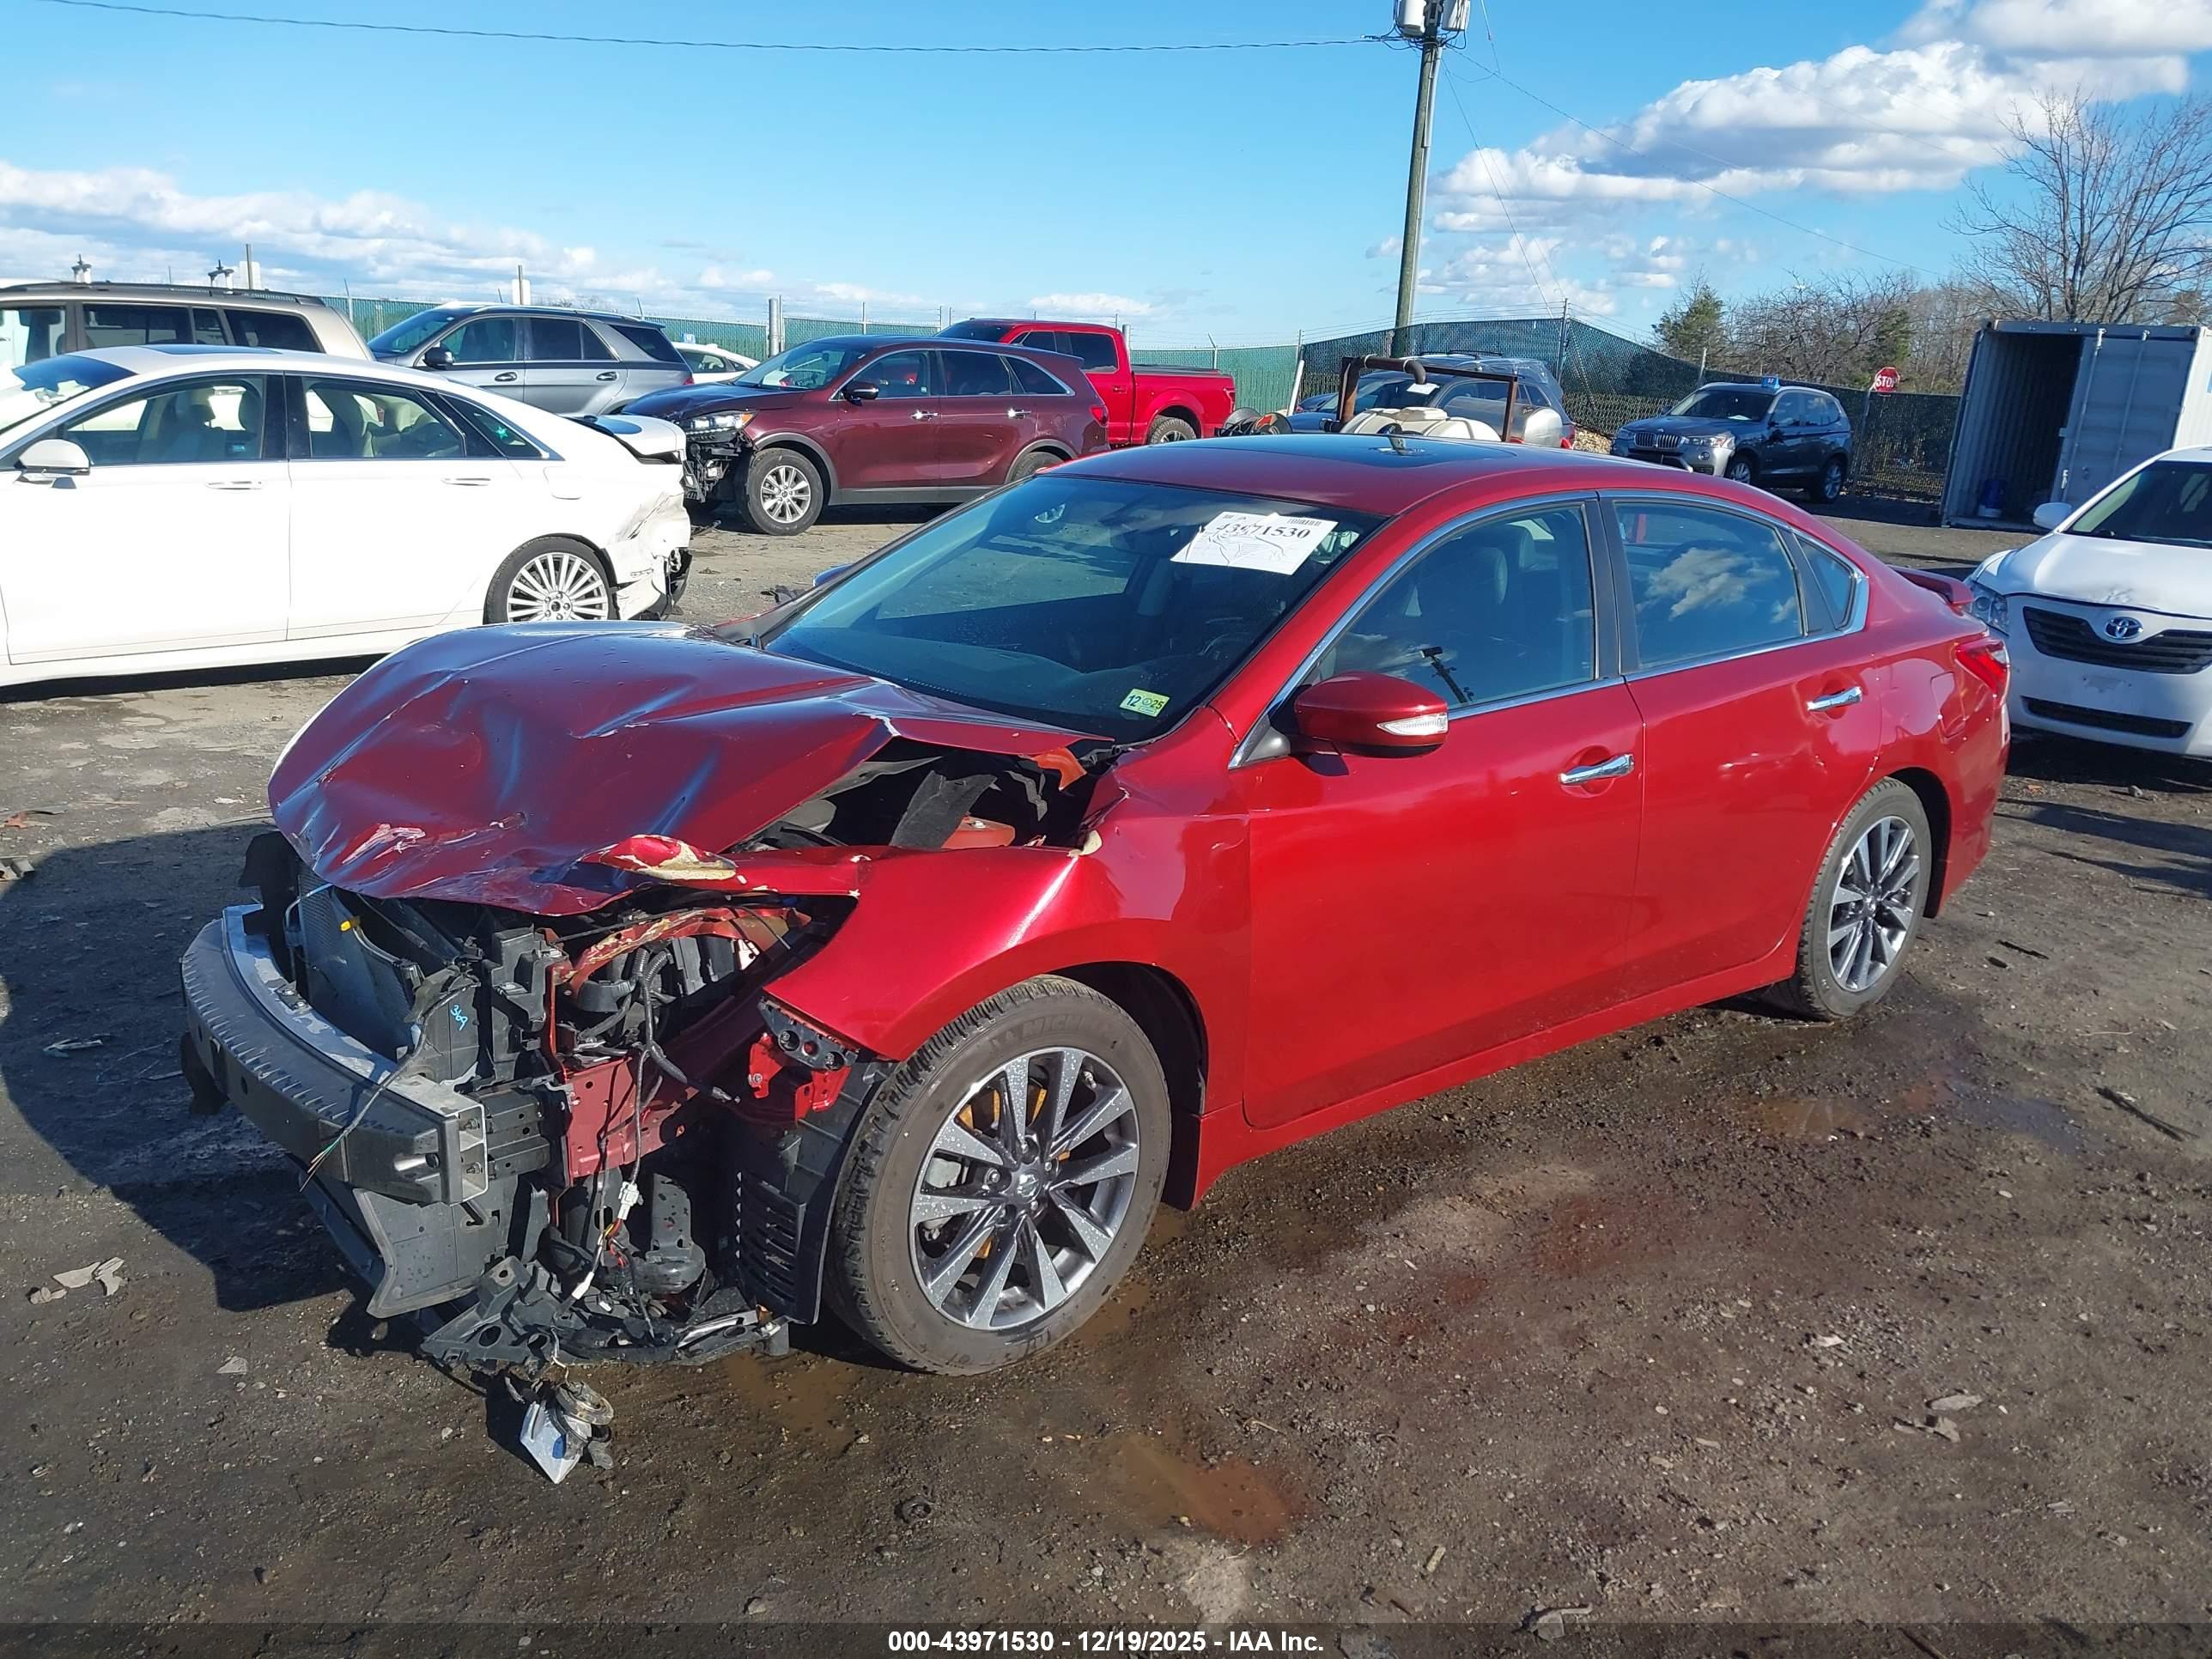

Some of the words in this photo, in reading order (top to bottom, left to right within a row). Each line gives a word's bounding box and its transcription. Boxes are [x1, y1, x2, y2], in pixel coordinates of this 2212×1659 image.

[1875, 374, 1897, 388] STOP
[1126, 694, 1142, 708] 12
[1150, 699, 1164, 709] 25
